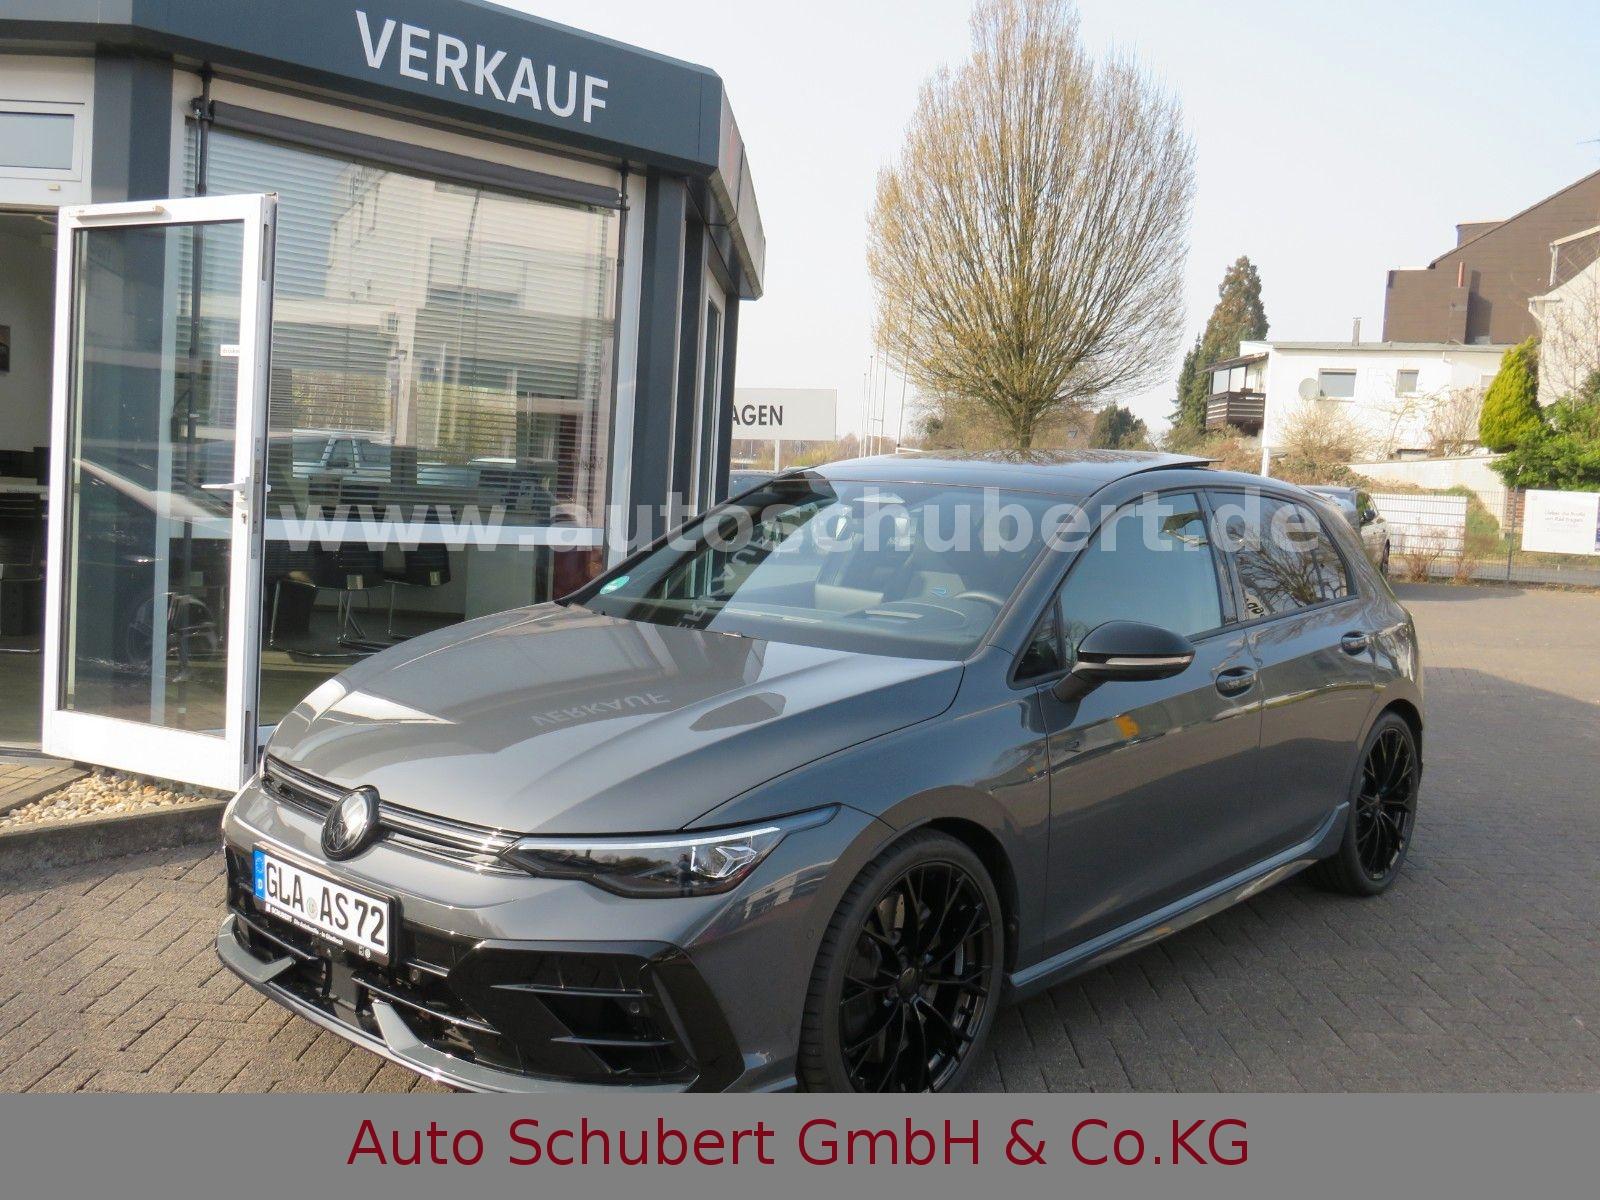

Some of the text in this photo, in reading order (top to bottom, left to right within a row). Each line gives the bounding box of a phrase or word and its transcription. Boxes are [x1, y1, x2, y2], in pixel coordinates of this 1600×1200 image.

[355, 10, 609, 124] VERKAUF
[266, 862, 304, 912] GLA
[320, 887, 349, 930] AS
[354, 898, 385, 946] 72
